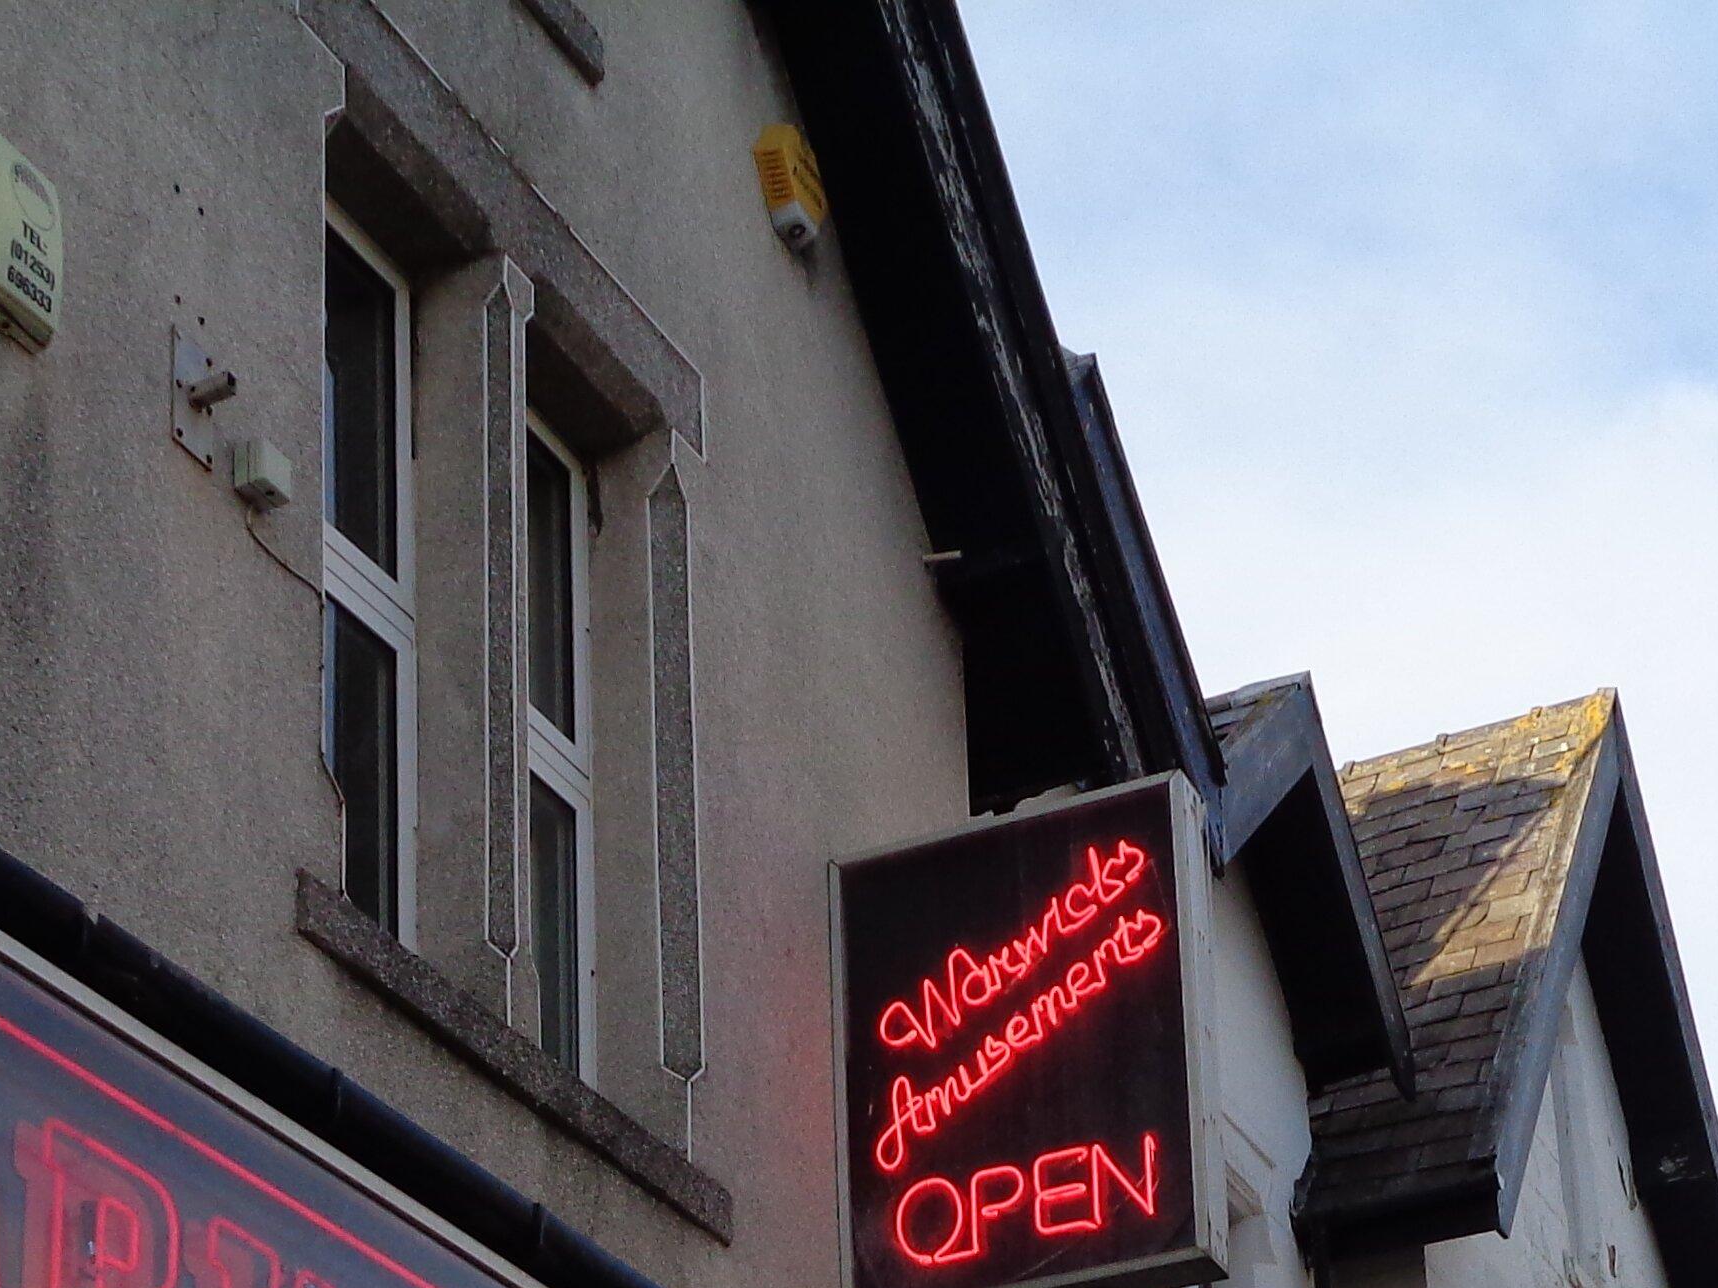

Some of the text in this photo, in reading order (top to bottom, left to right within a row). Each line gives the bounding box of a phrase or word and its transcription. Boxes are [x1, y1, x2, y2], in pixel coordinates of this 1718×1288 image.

[7, 264, 52, 314] 696333
[10, 239, 55, 291] (01253)
[878, 838, 1147, 1050] Warwicks
[875, 906, 1166, 1173] Amusements
[894, 1132, 1159, 1266] OPEN
